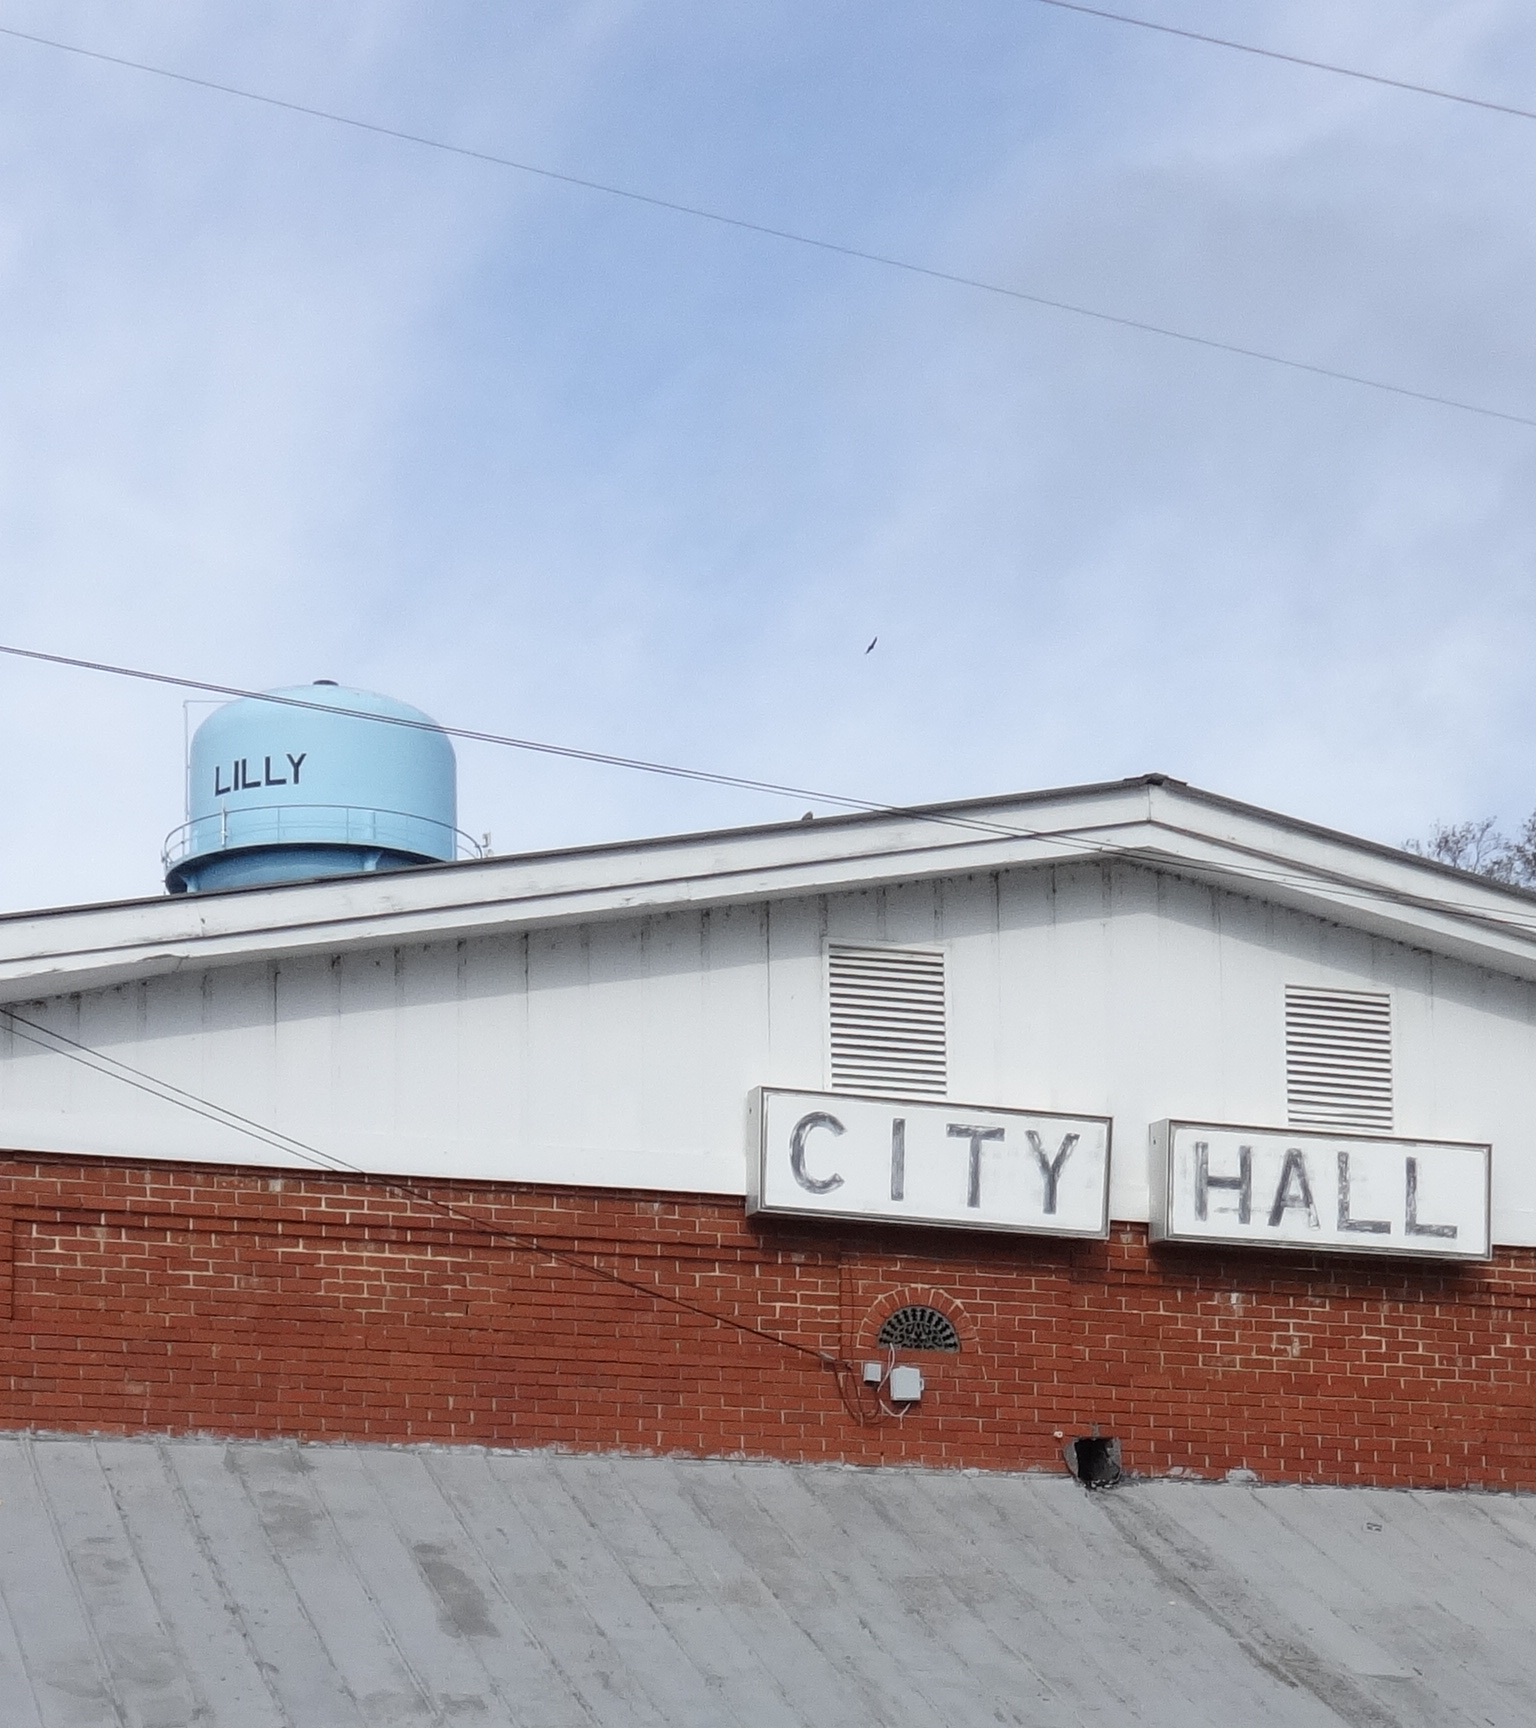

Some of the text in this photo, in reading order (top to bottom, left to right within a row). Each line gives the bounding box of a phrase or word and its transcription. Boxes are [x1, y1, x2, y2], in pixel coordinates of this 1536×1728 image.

[215, 753, 307, 796] LILLY
[789, 1111, 1458, 1239] CITY HALL
